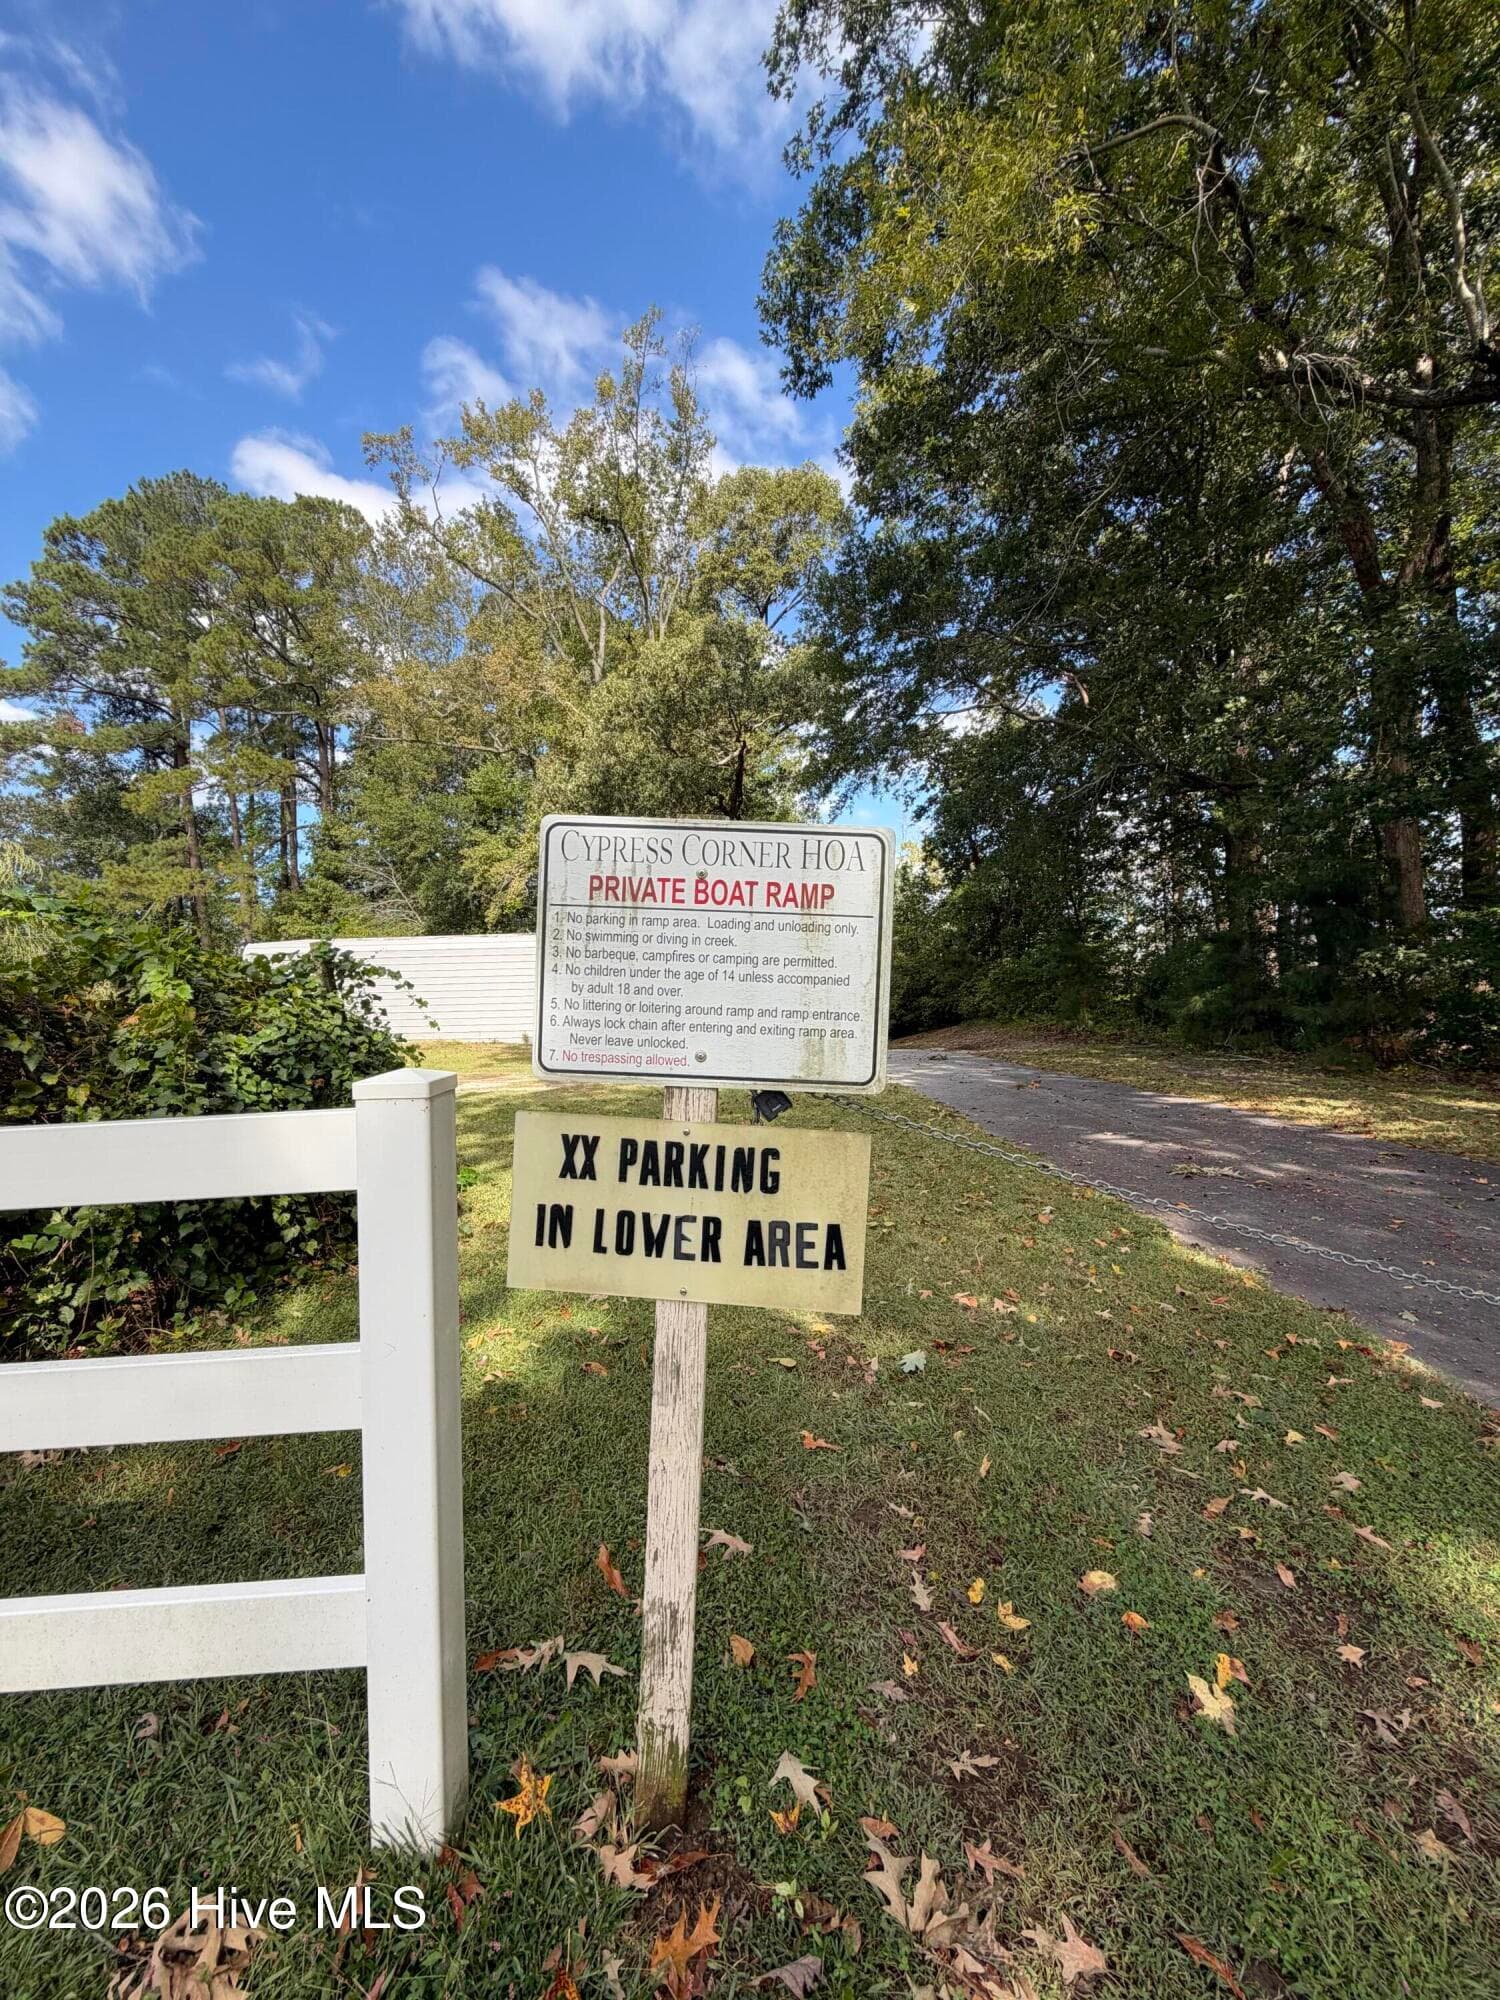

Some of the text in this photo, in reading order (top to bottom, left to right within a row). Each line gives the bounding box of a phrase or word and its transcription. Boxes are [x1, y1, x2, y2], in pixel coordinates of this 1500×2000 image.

[561, 830, 866, 871] CYPRESS CORNER HOA
[589, 875, 835, 909] PRIVATE BOAT RAMP
[554, 912, 859, 937] 1. No parking in ramp area. Loading and unloading only.
[552, 929, 737, 948] 2. No swimming or diving in creek.
[552, 946, 837, 969] 3. No barbeque, campfires or camping are permitted.
[552, 963, 849, 988] 4. No children under the age of 14 unless accompanied
[572, 981, 683, 997] by adult 18 and over.
[551, 998, 863, 1022] 5. No littering or loitering around ramp and ramp entrance.
[550, 1015, 857, 1040] 6. Always lock chain after entering and exiting ramp area.
[570, 1034, 688, 1049] Never leave unlocked.
[549, 1050, 689, 1067] 7. No trespassing allowed.
[559, 1133, 781, 1194] XX PARKING
[535, 1203, 846, 1270] IN LOWER AREA
